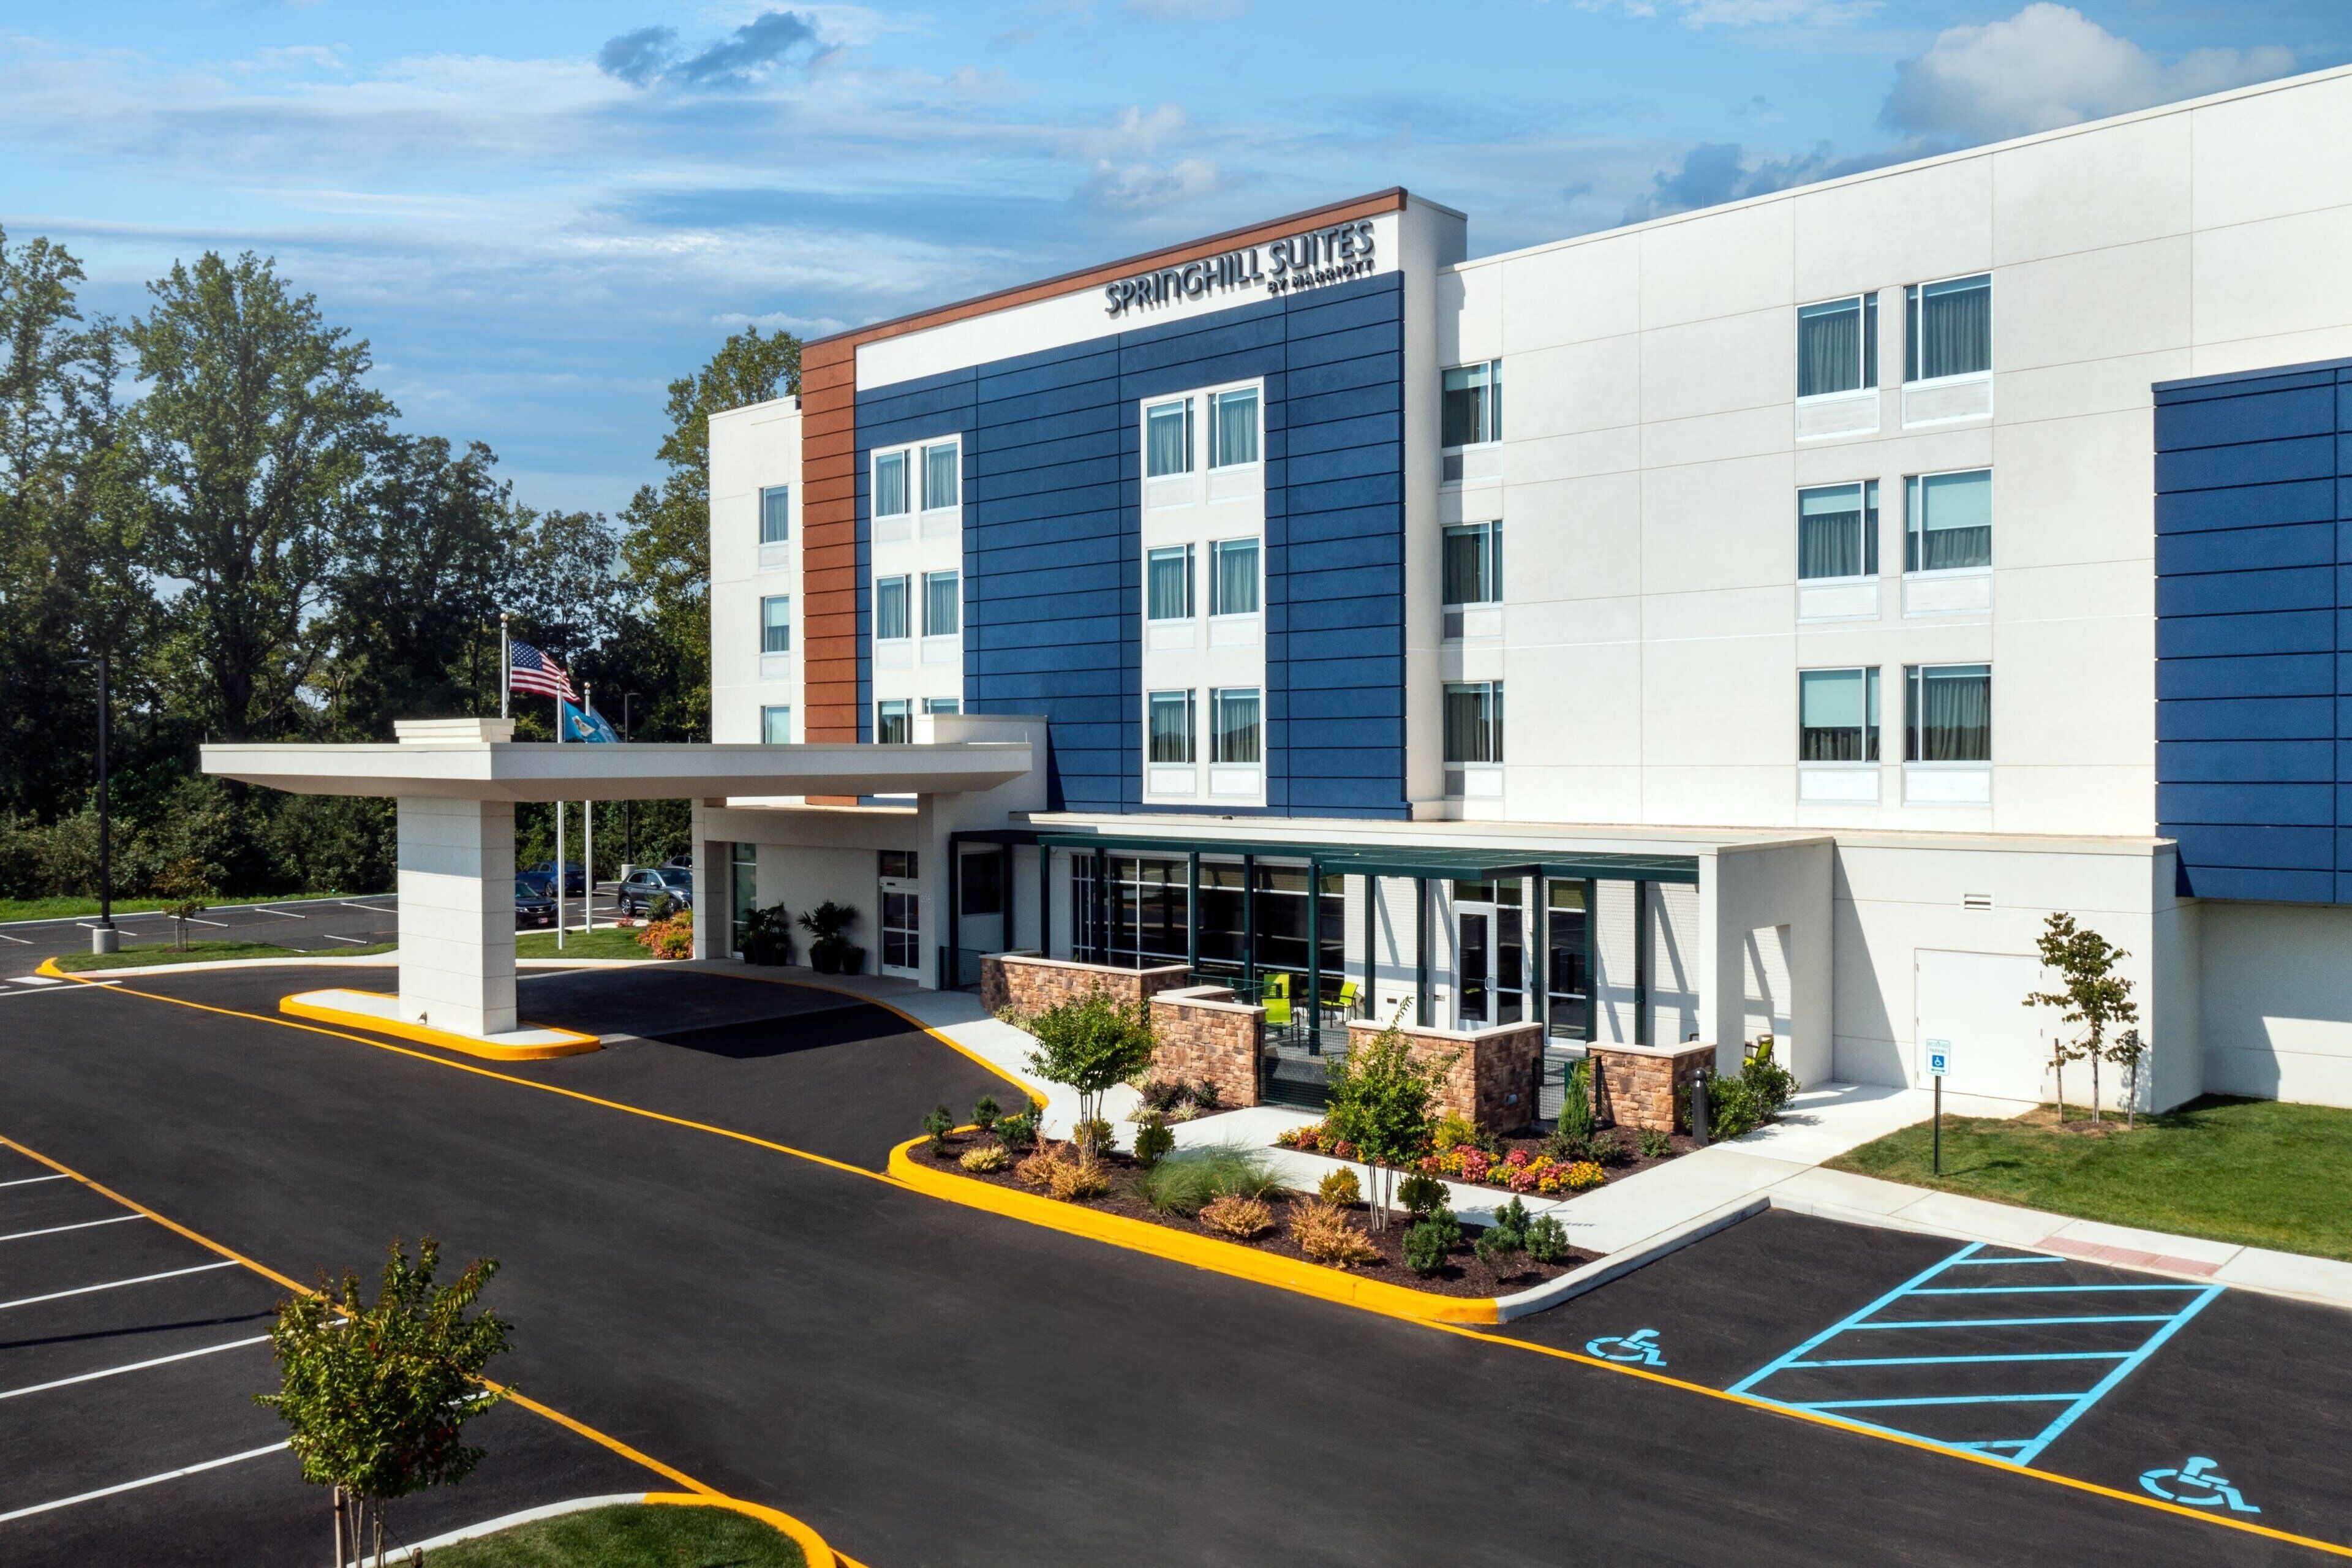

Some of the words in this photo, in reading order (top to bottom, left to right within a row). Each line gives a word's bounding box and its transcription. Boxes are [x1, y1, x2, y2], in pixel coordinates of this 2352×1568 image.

[1104, 249, 1264, 314] SPRINGHILL
[1268, 221, 1374, 274] SUITES
[1267, 277, 1288, 293] BY
[1292, 258, 1374, 288] MARRIOTT
